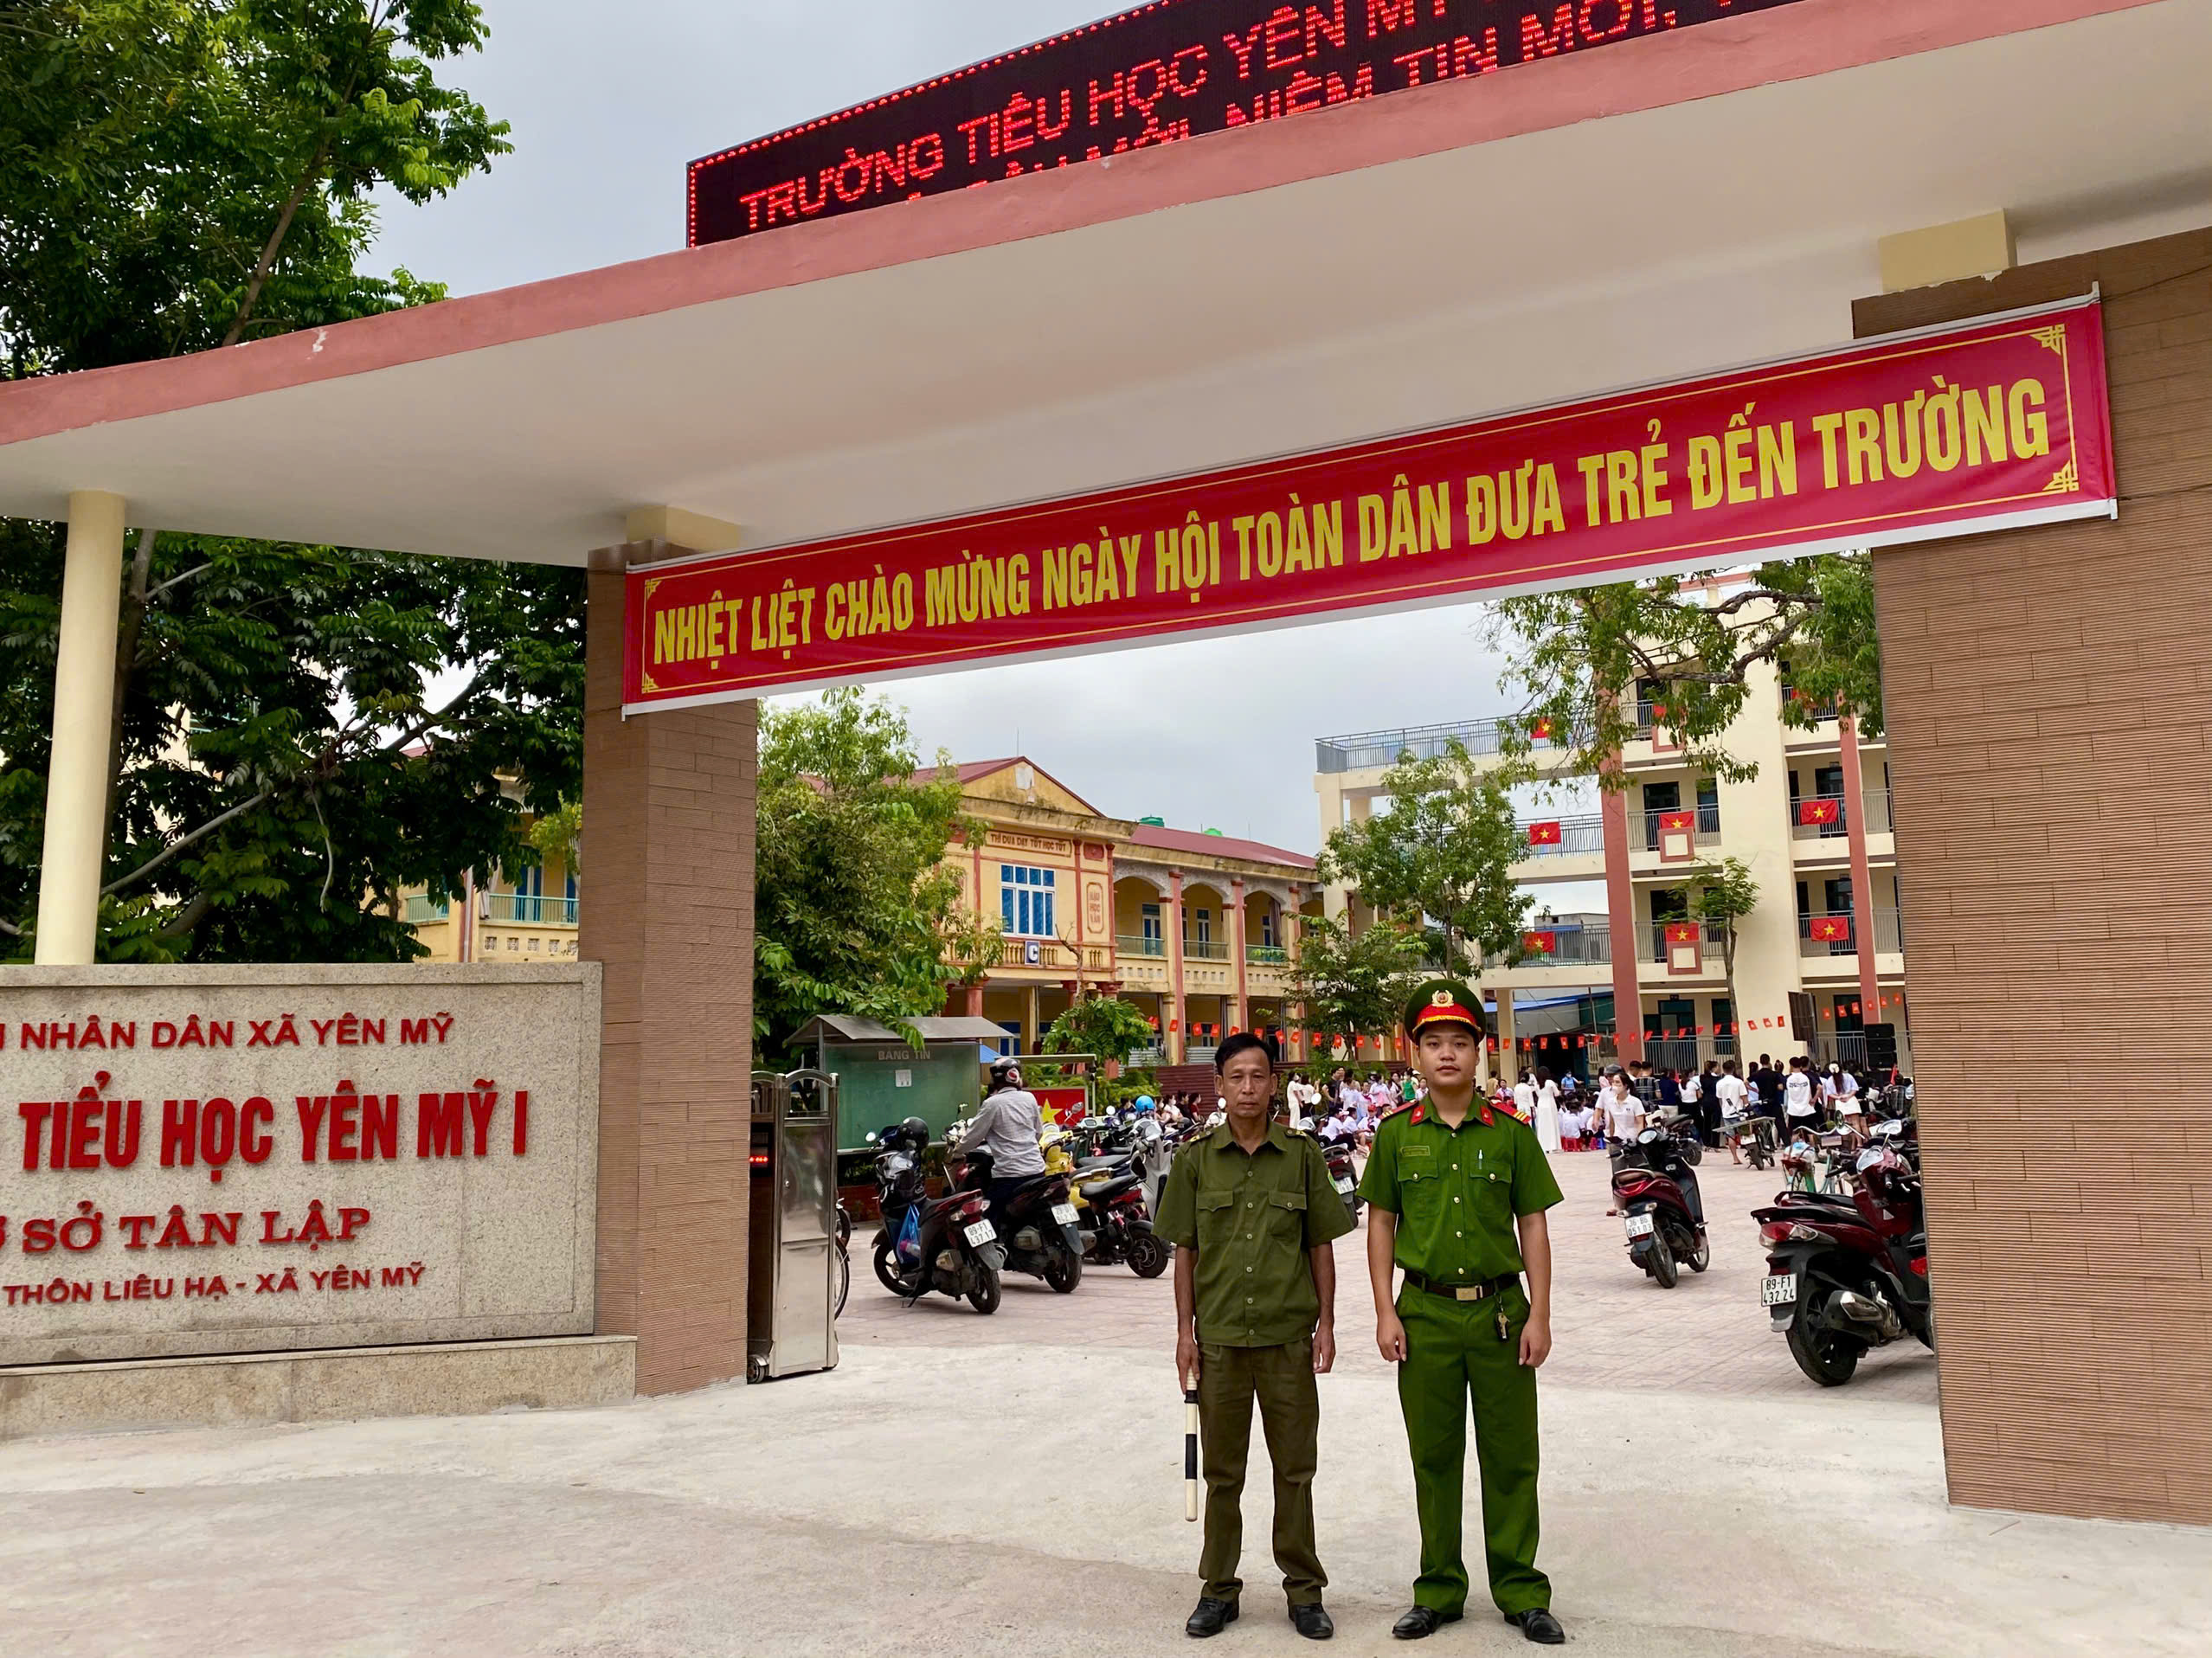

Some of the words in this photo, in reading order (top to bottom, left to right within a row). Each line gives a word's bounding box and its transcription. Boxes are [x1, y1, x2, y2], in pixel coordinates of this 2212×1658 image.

[653, 590, 743, 670] NHIỆT
[751, 578, 816, 660] LIỆT
[825, 564, 915, 641] CHÀO
[925, 549, 1031, 627] MỪNG
[1042, 525, 1142, 610] NGÀY
[1155, 510, 1220, 604] HỘI
[1232, 492, 1344, 581] TOÀN
[1358, 472, 1452, 562] DÂN
[1465, 459, 1566, 546] ĐƯA
[1577, 418, 1673, 527] TRẺ
[1687, 402, 1797, 511] ĐẾN
[1811, 374, 2051, 490] TRƯỜNG
[1028, 944, 1038, 961] C
[20, 1014, 137, 1050] NHÂN
[151, 1014, 235, 1049] DÂN
[248, 1012, 299, 1047] XÃ
[312, 1012, 386, 1045] YÊN
[400, 1012, 454, 1044] MỸ
[19, 1070, 143, 1171] TIỂU
[160, 1096, 274, 1183] HỌC
[295, 1079, 399, 1162] YÊN
[417, 1077, 499, 1158] MỸ
[513, 1090, 529, 1155] I
[23, 1200, 104, 1254] SỞ
[119, 1205, 243, 1250] TÂN
[259, 1199, 371, 1251] LẬP
[3, 1277, 93, 1306] THÔN
[103, 1274, 174, 1301] LIÊU
[184, 1276, 228, 1301] HẠ
[255, 1267, 299, 1295] XÃ
[310, 1263, 371, 1291] YÊN
[381, 1261, 426, 1288] MỸ
[1765, 1276, 1791, 1291] 89-F1
